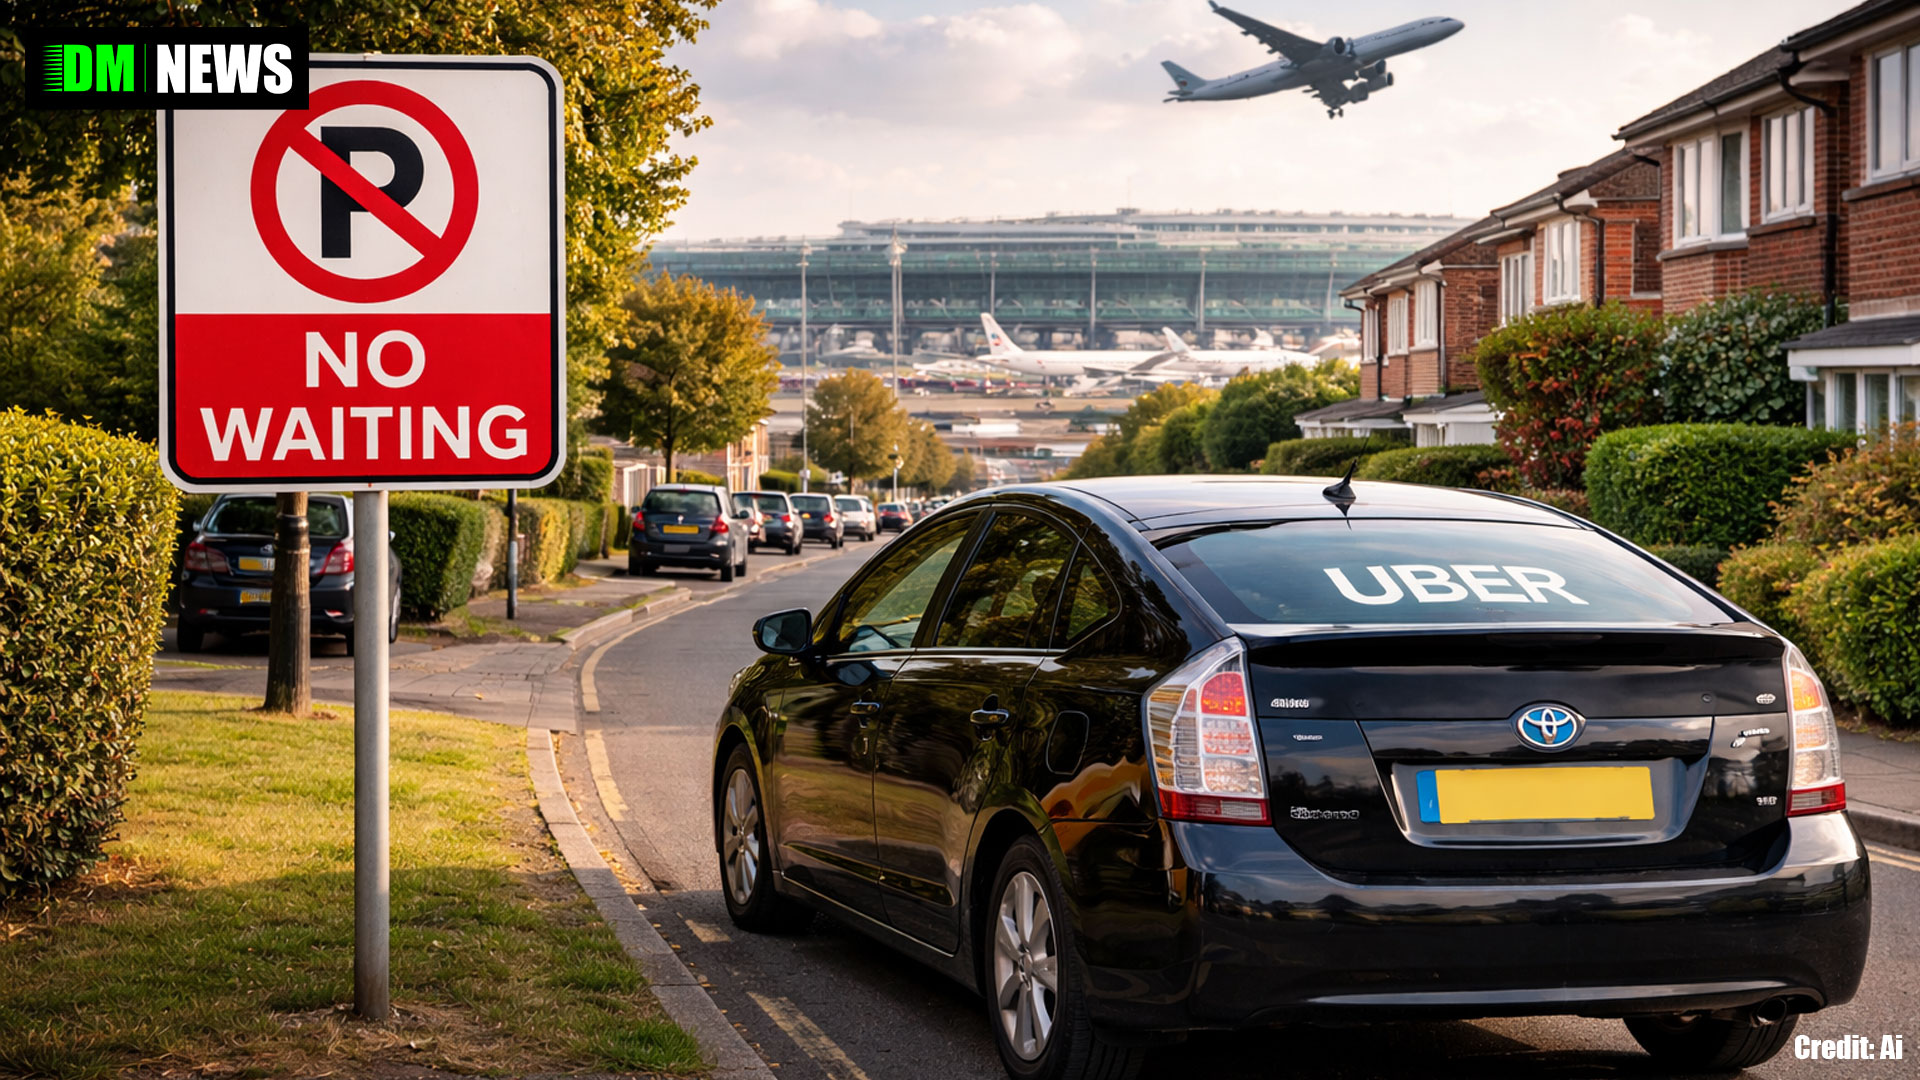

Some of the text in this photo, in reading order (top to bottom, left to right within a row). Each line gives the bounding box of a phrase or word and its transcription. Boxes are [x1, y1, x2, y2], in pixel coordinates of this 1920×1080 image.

[320, 126, 424, 259] P
[305, 329, 426, 389] NO
[199, 404, 528, 462] WAITING
[1323, 563, 1589, 606] UBER
